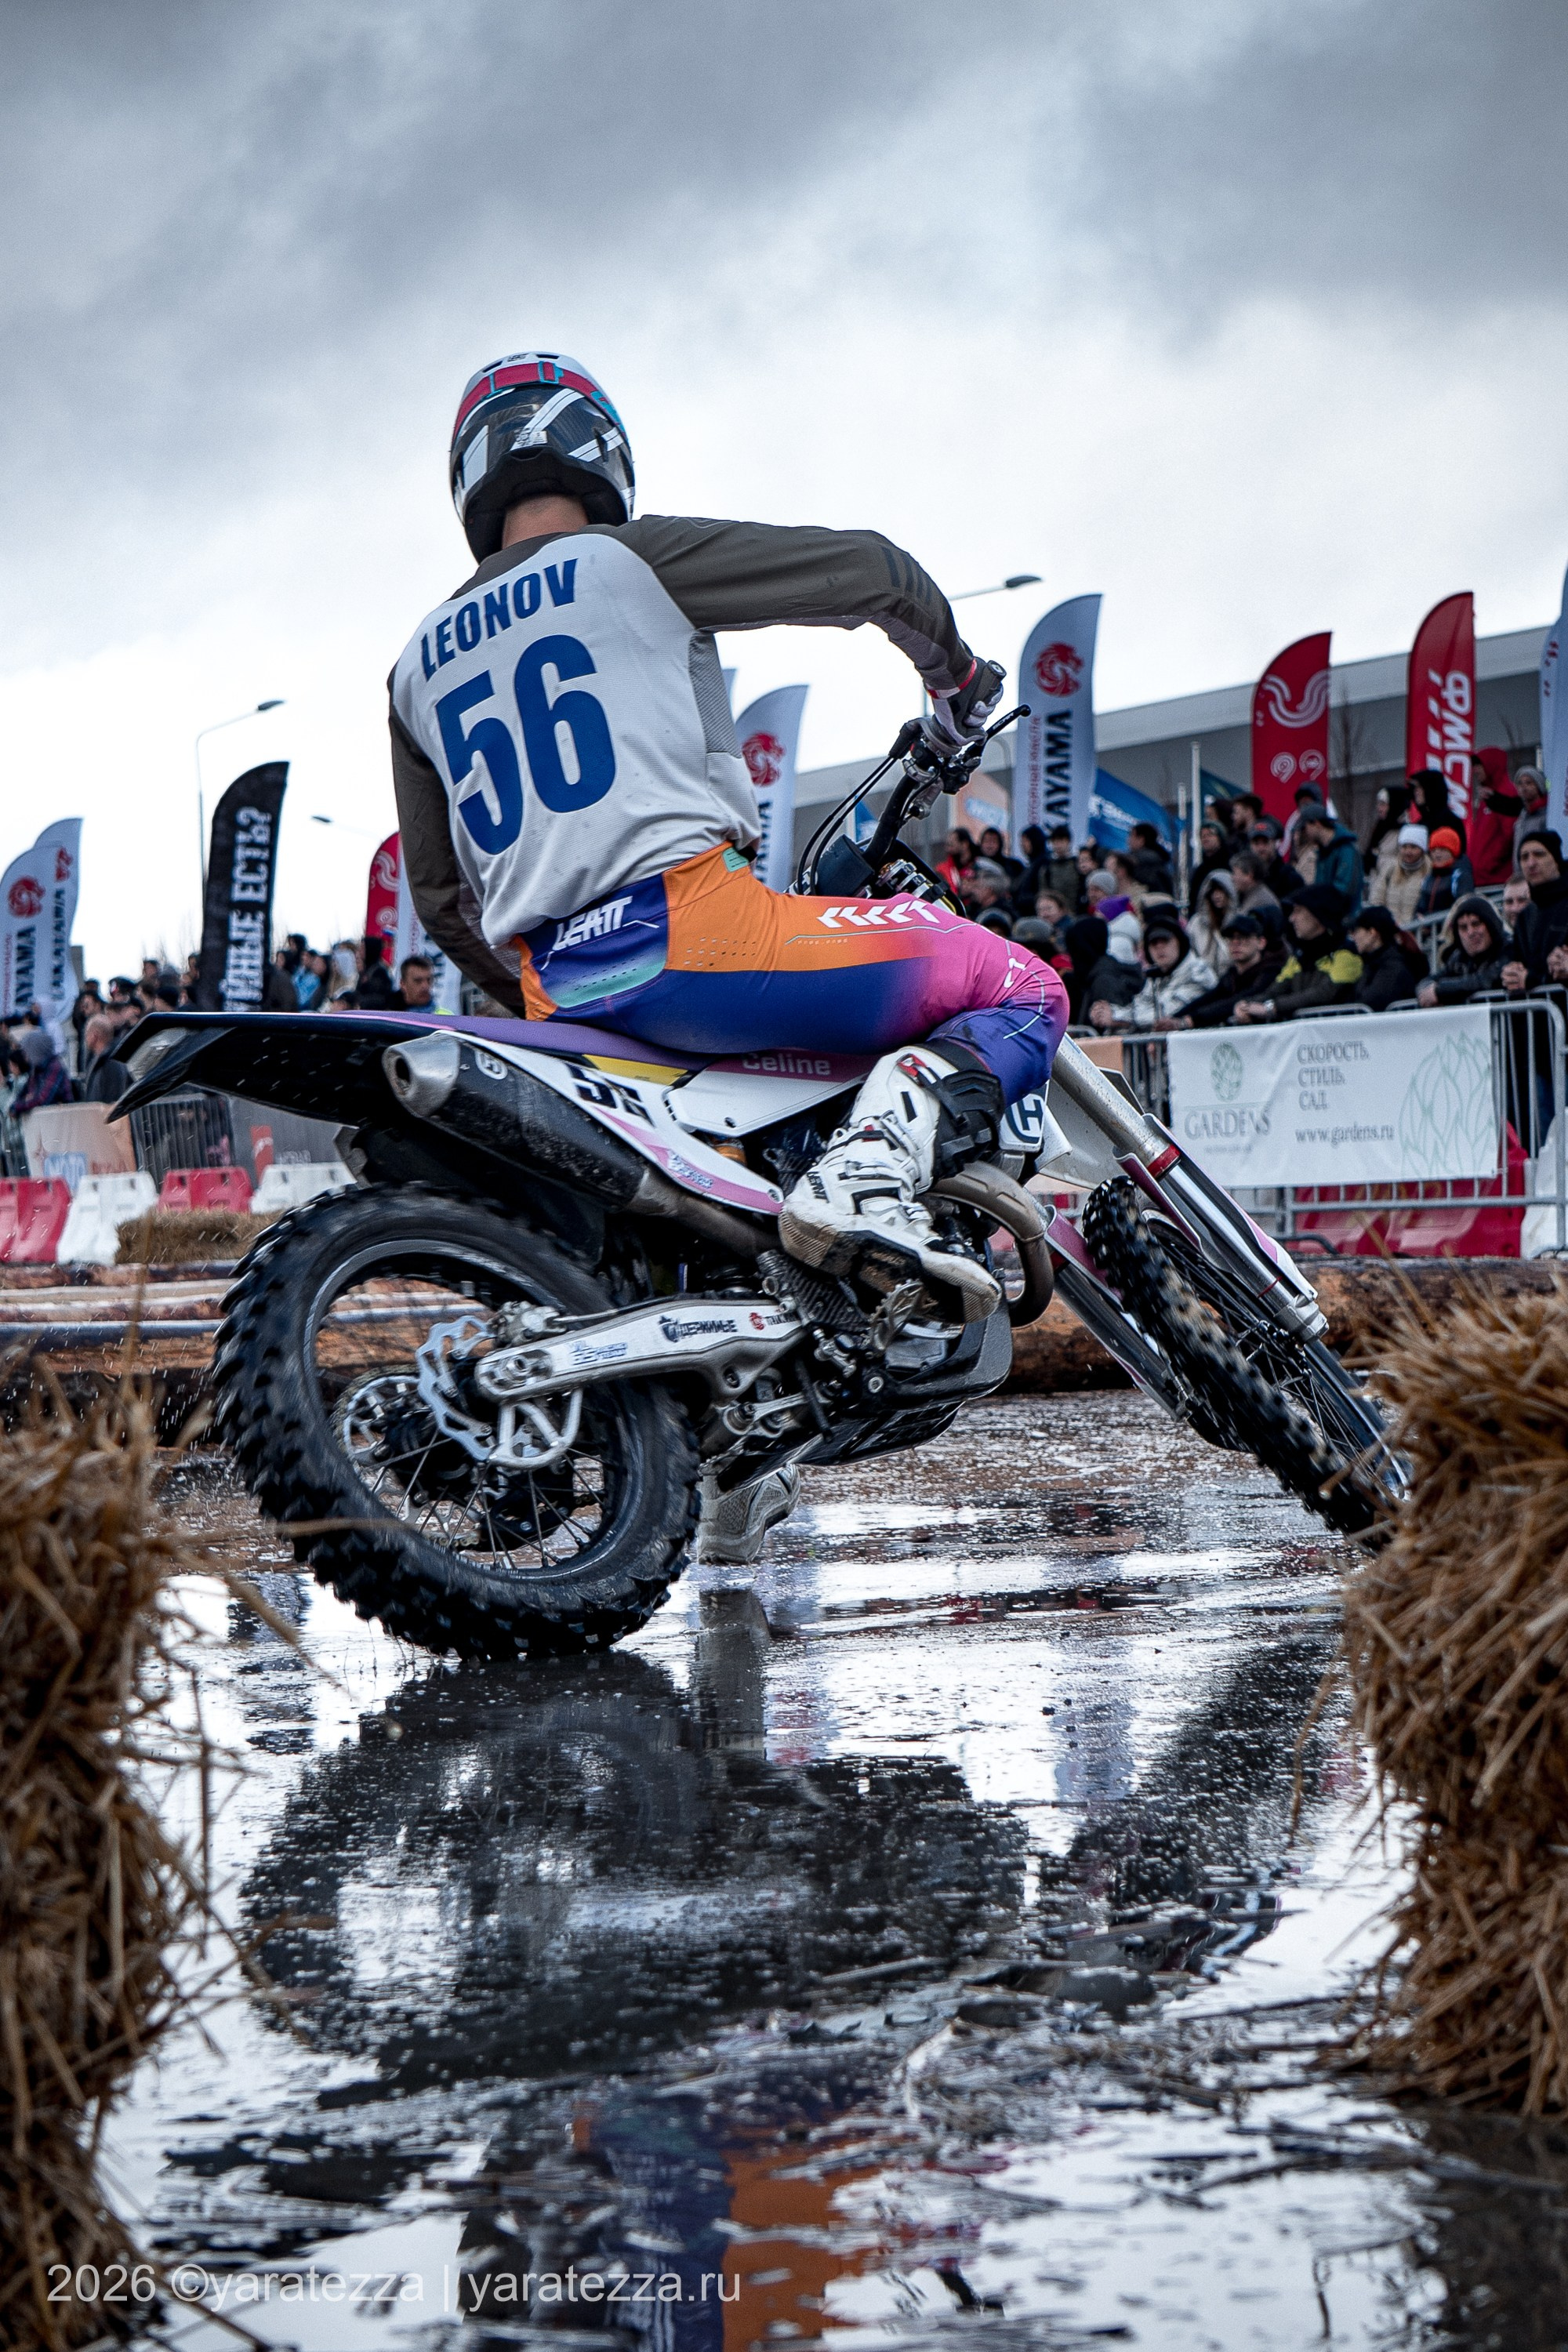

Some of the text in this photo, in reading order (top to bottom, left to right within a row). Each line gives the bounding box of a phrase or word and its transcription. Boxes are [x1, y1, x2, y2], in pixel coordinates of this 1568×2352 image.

[420, 557, 579, 682] LEONOV
[434, 633, 617, 856] 56
[230, 805, 272, 903] ЕСТЬ?
[742, 1053, 832, 1076] Celine
